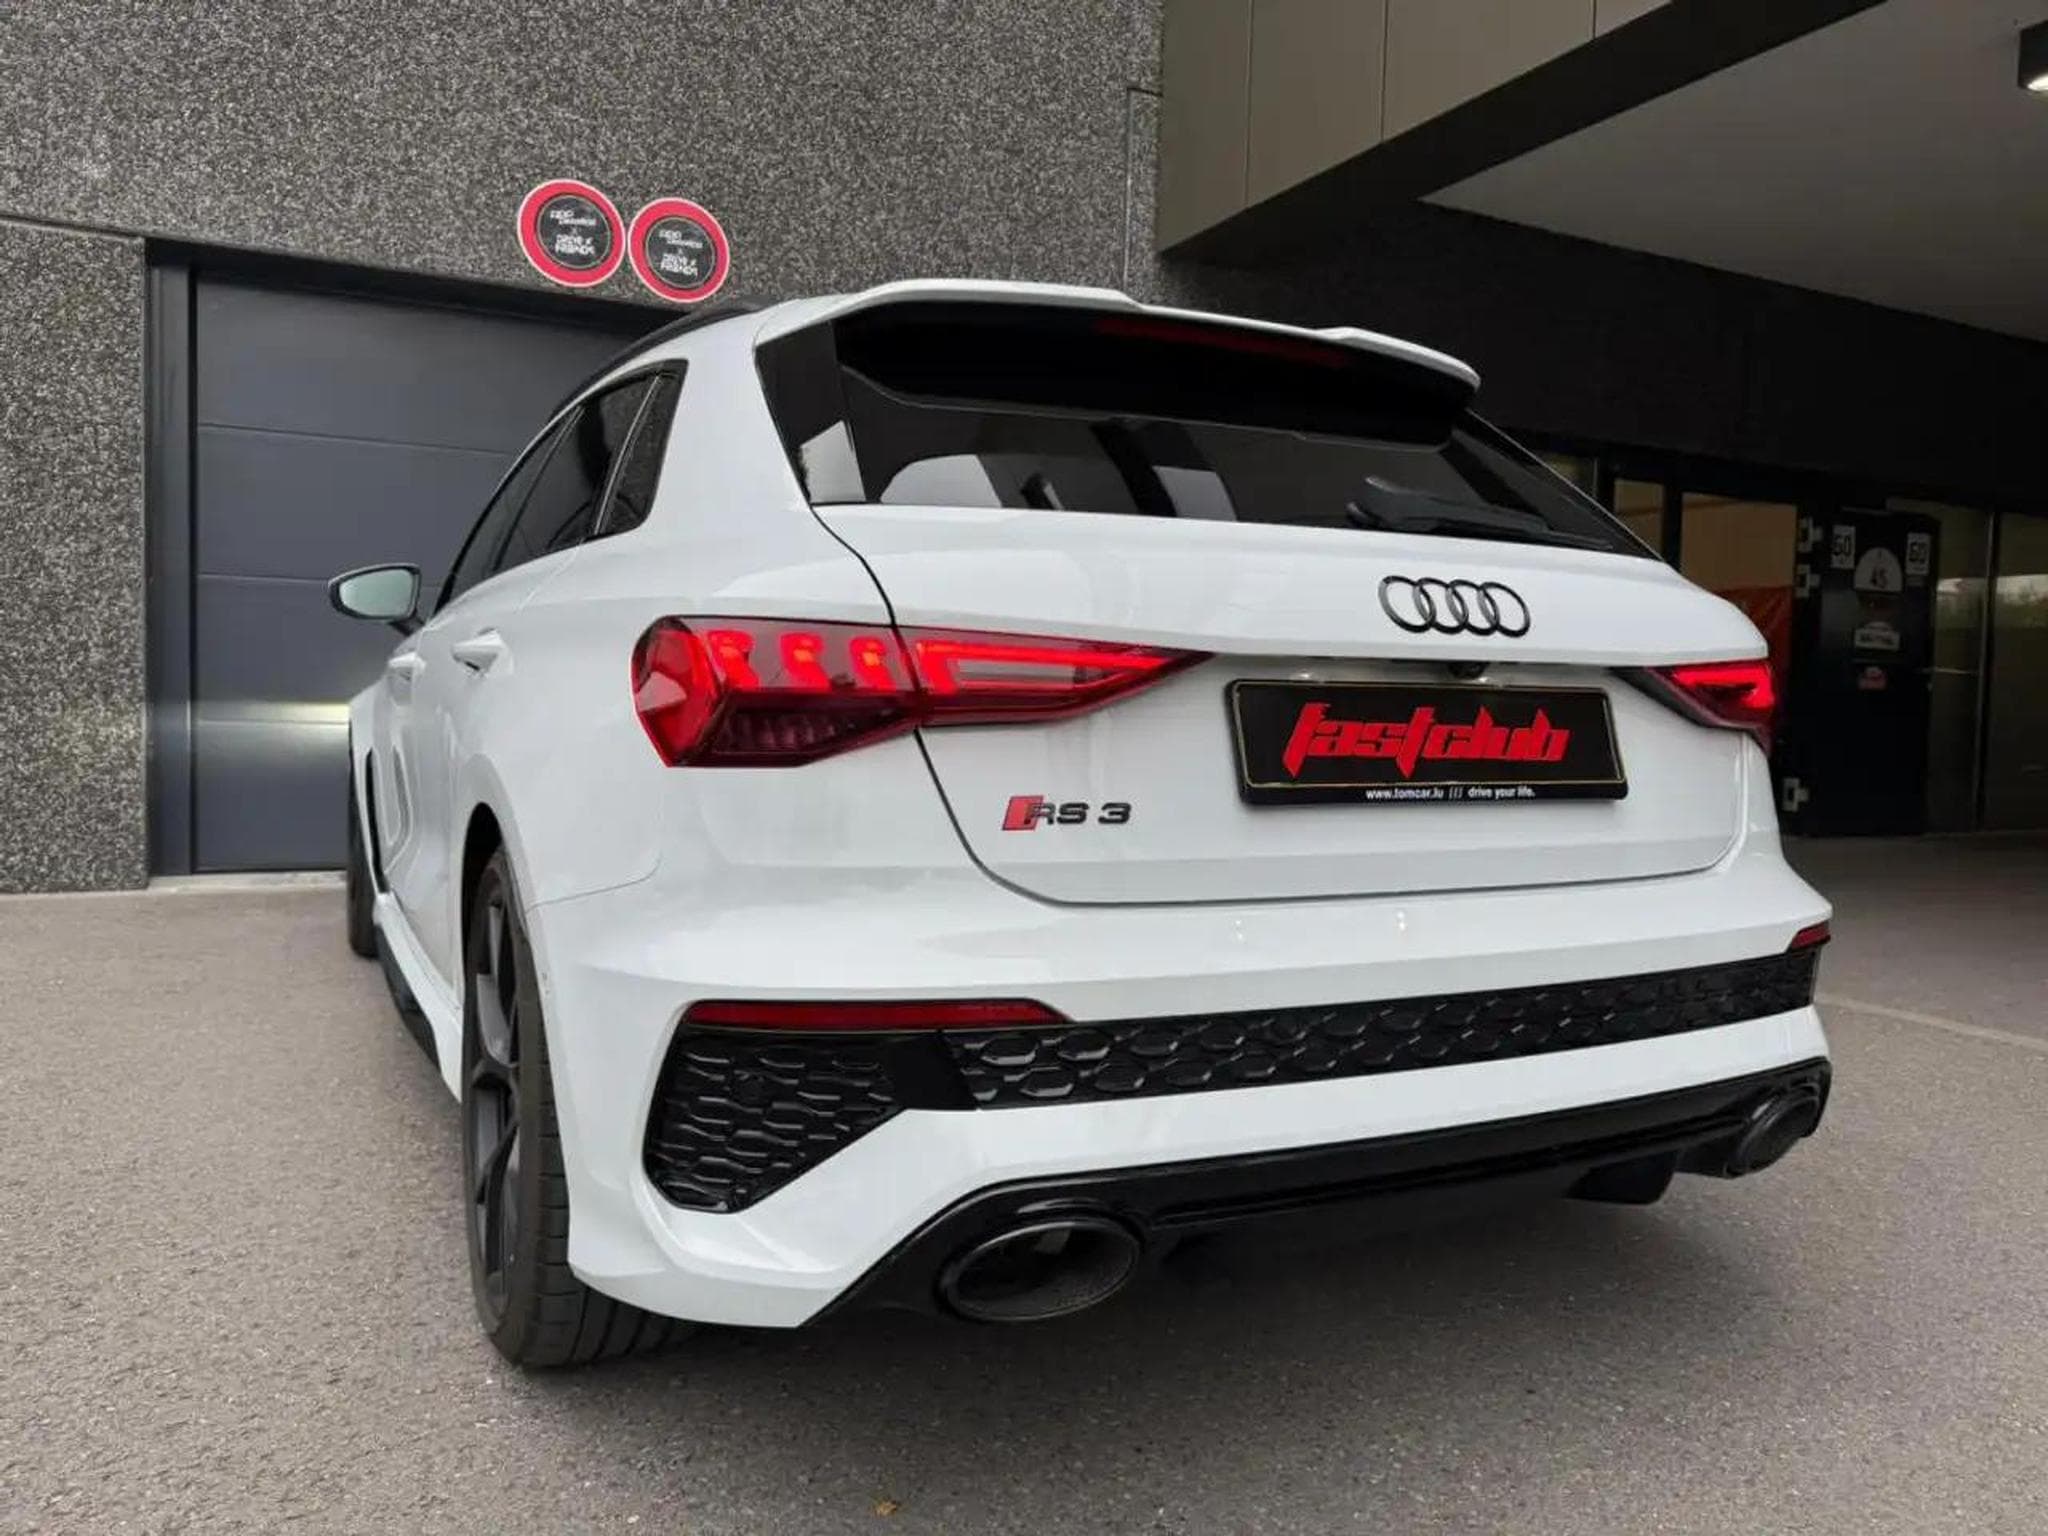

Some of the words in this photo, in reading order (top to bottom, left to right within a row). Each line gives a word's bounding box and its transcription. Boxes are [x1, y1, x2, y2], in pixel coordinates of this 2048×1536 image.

[1468, 786, 1493, 798] drive
[1495, 788, 1516, 799] your
[1098, 802, 1132, 826] 3
